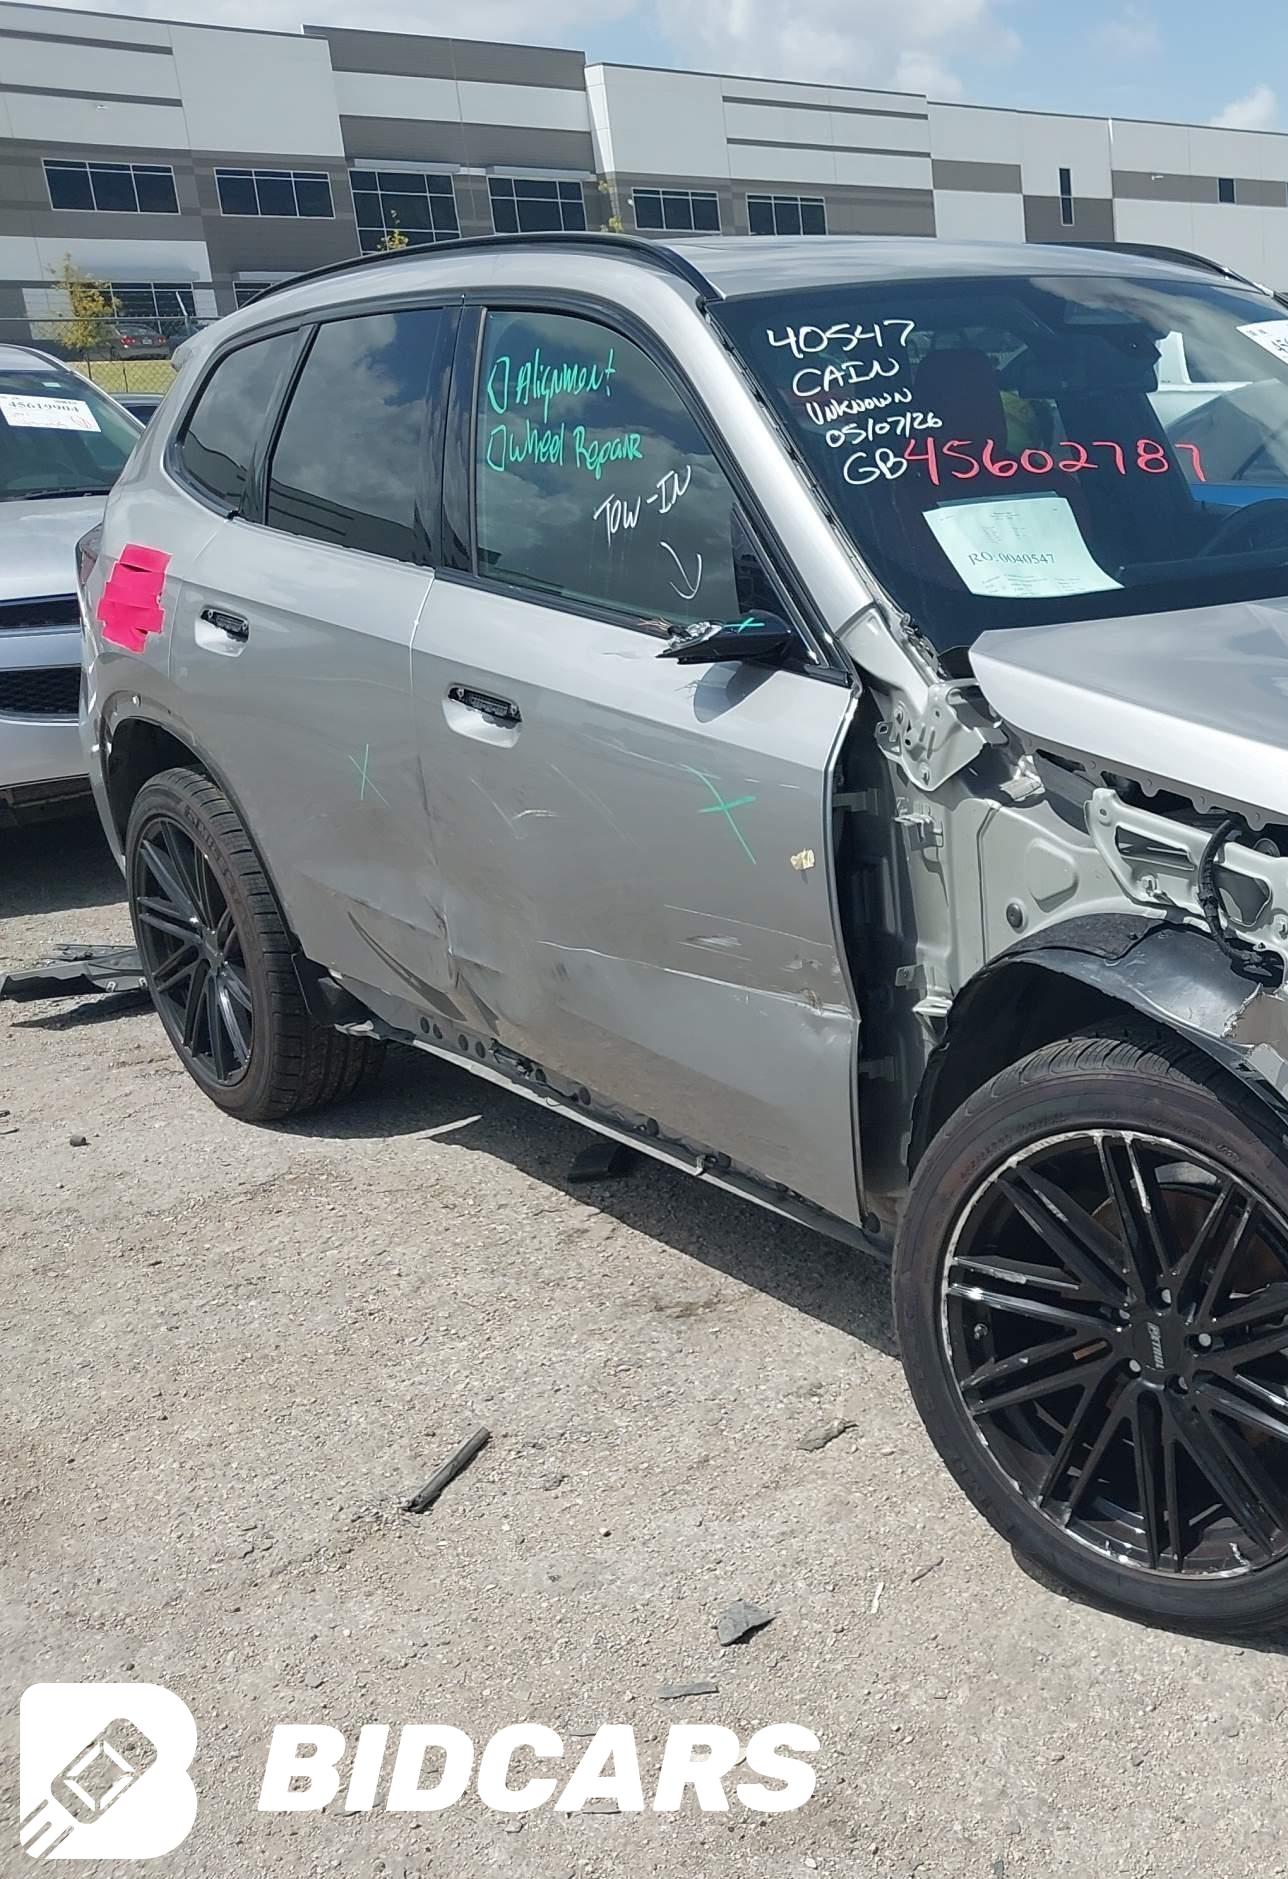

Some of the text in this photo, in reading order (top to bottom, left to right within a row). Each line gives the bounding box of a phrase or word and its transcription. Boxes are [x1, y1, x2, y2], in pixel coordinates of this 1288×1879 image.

[768, 319, 915, 358] 40547
[792, 356, 899, 397] CAIN
[825, 411, 943, 448] 05/07/26
[904, 436, 1206, 486] 45602787
